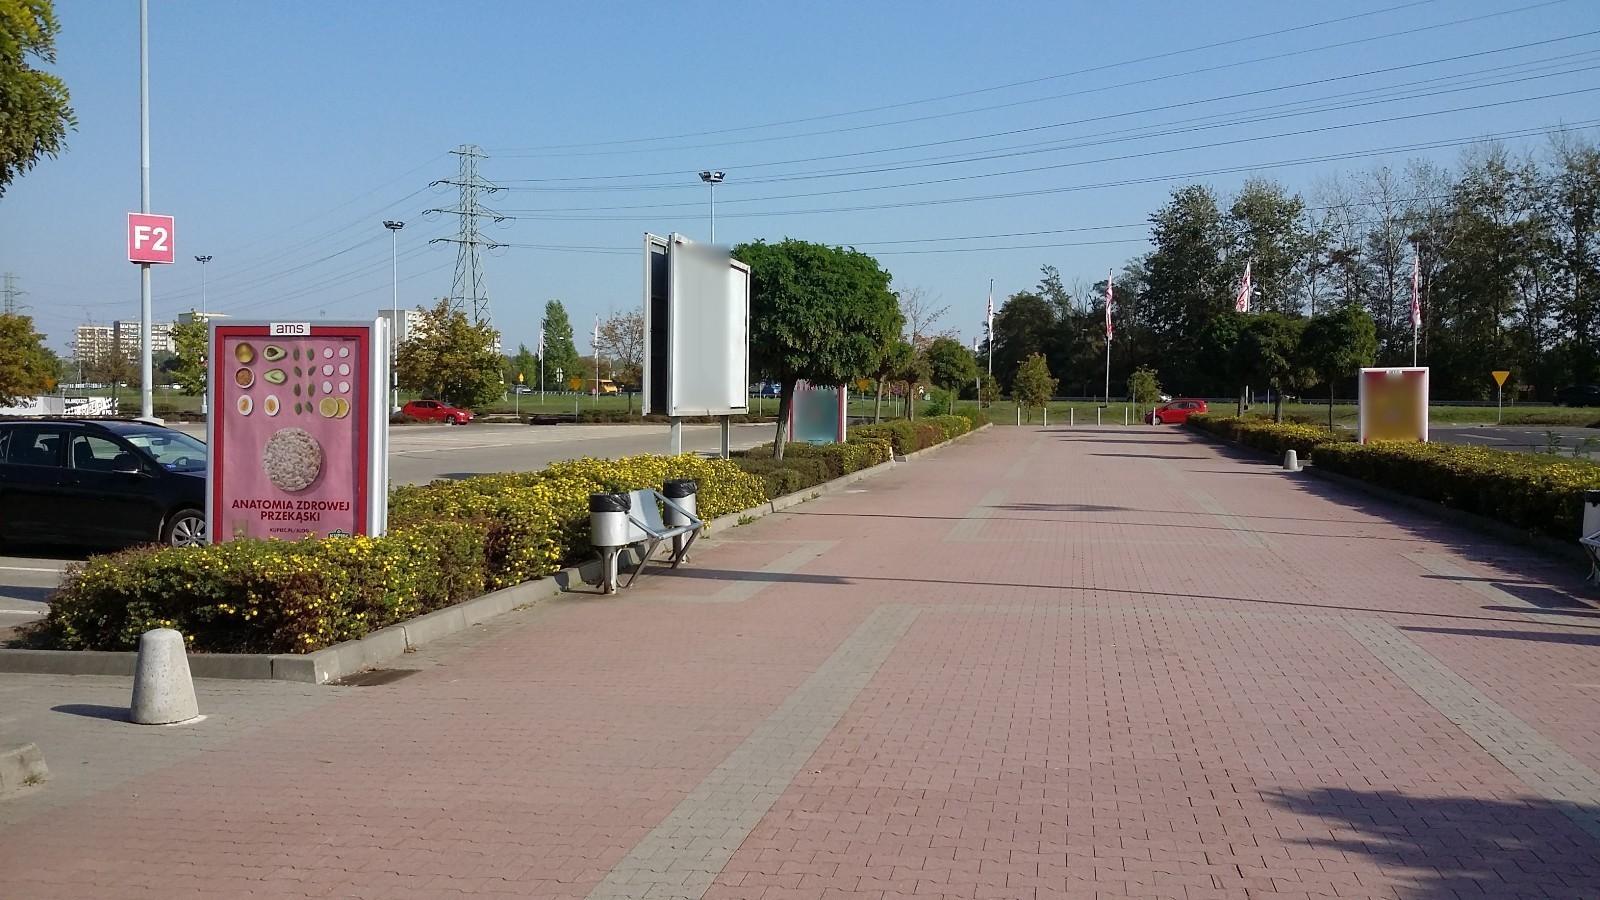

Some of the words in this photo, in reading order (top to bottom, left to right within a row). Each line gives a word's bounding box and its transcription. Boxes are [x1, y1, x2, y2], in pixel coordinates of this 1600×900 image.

[135, 225, 168, 251] F2
[276, 324, 304, 334] ams
[231, 499, 294, 510] ANATOMIA
[296, 500, 350, 511] ZDROWEJ
[260, 510, 320, 523] PRZEKĄSKI
